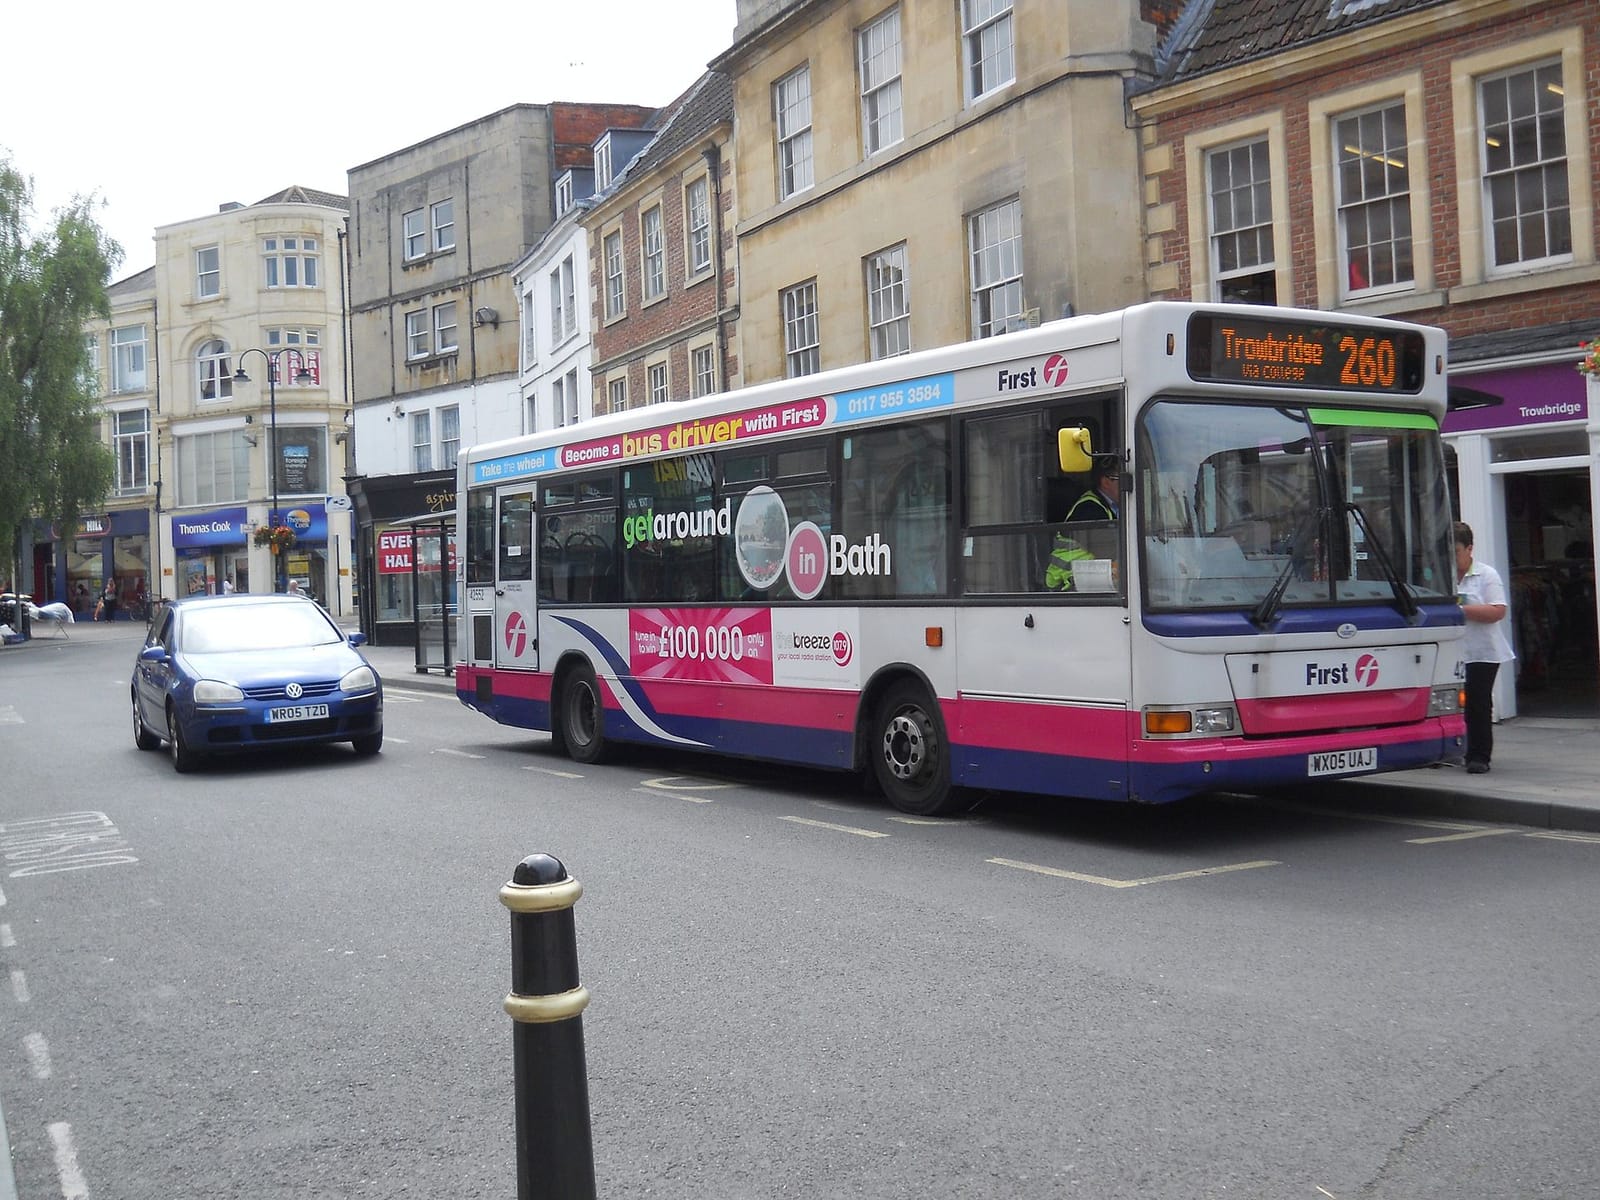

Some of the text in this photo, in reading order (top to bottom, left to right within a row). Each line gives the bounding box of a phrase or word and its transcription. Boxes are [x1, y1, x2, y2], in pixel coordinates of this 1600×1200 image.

[1221, 328, 1396, 387] Trowbridge 260
[999, 367, 1037, 391] First
[848, 383, 940, 414] 0117 955 3584
[1519, 402, 1581, 417] Trowbridge
[565, 404, 819, 463] Become a bus driver with First
[480, 455, 545, 477] Take the wheel
[426, 489, 457, 512] aspir
[179, 523, 210, 535] Thomas
[211, 521, 231, 532] Cook
[385, 555, 413, 568] HAL
[799, 547, 816, 575] in
[830, 533, 892, 576] Bath
[635, 632, 649, 641] tune
[659, 626, 743, 662] £100,000
[747, 633, 764, 647] only
[793, 632, 831, 650] breeze
[747, 648, 758, 657] on
[1307, 663, 1348, 686] First
[272, 705, 327, 720] WR05 TZD
[1313, 750, 1372, 772] WX05 UAJ
